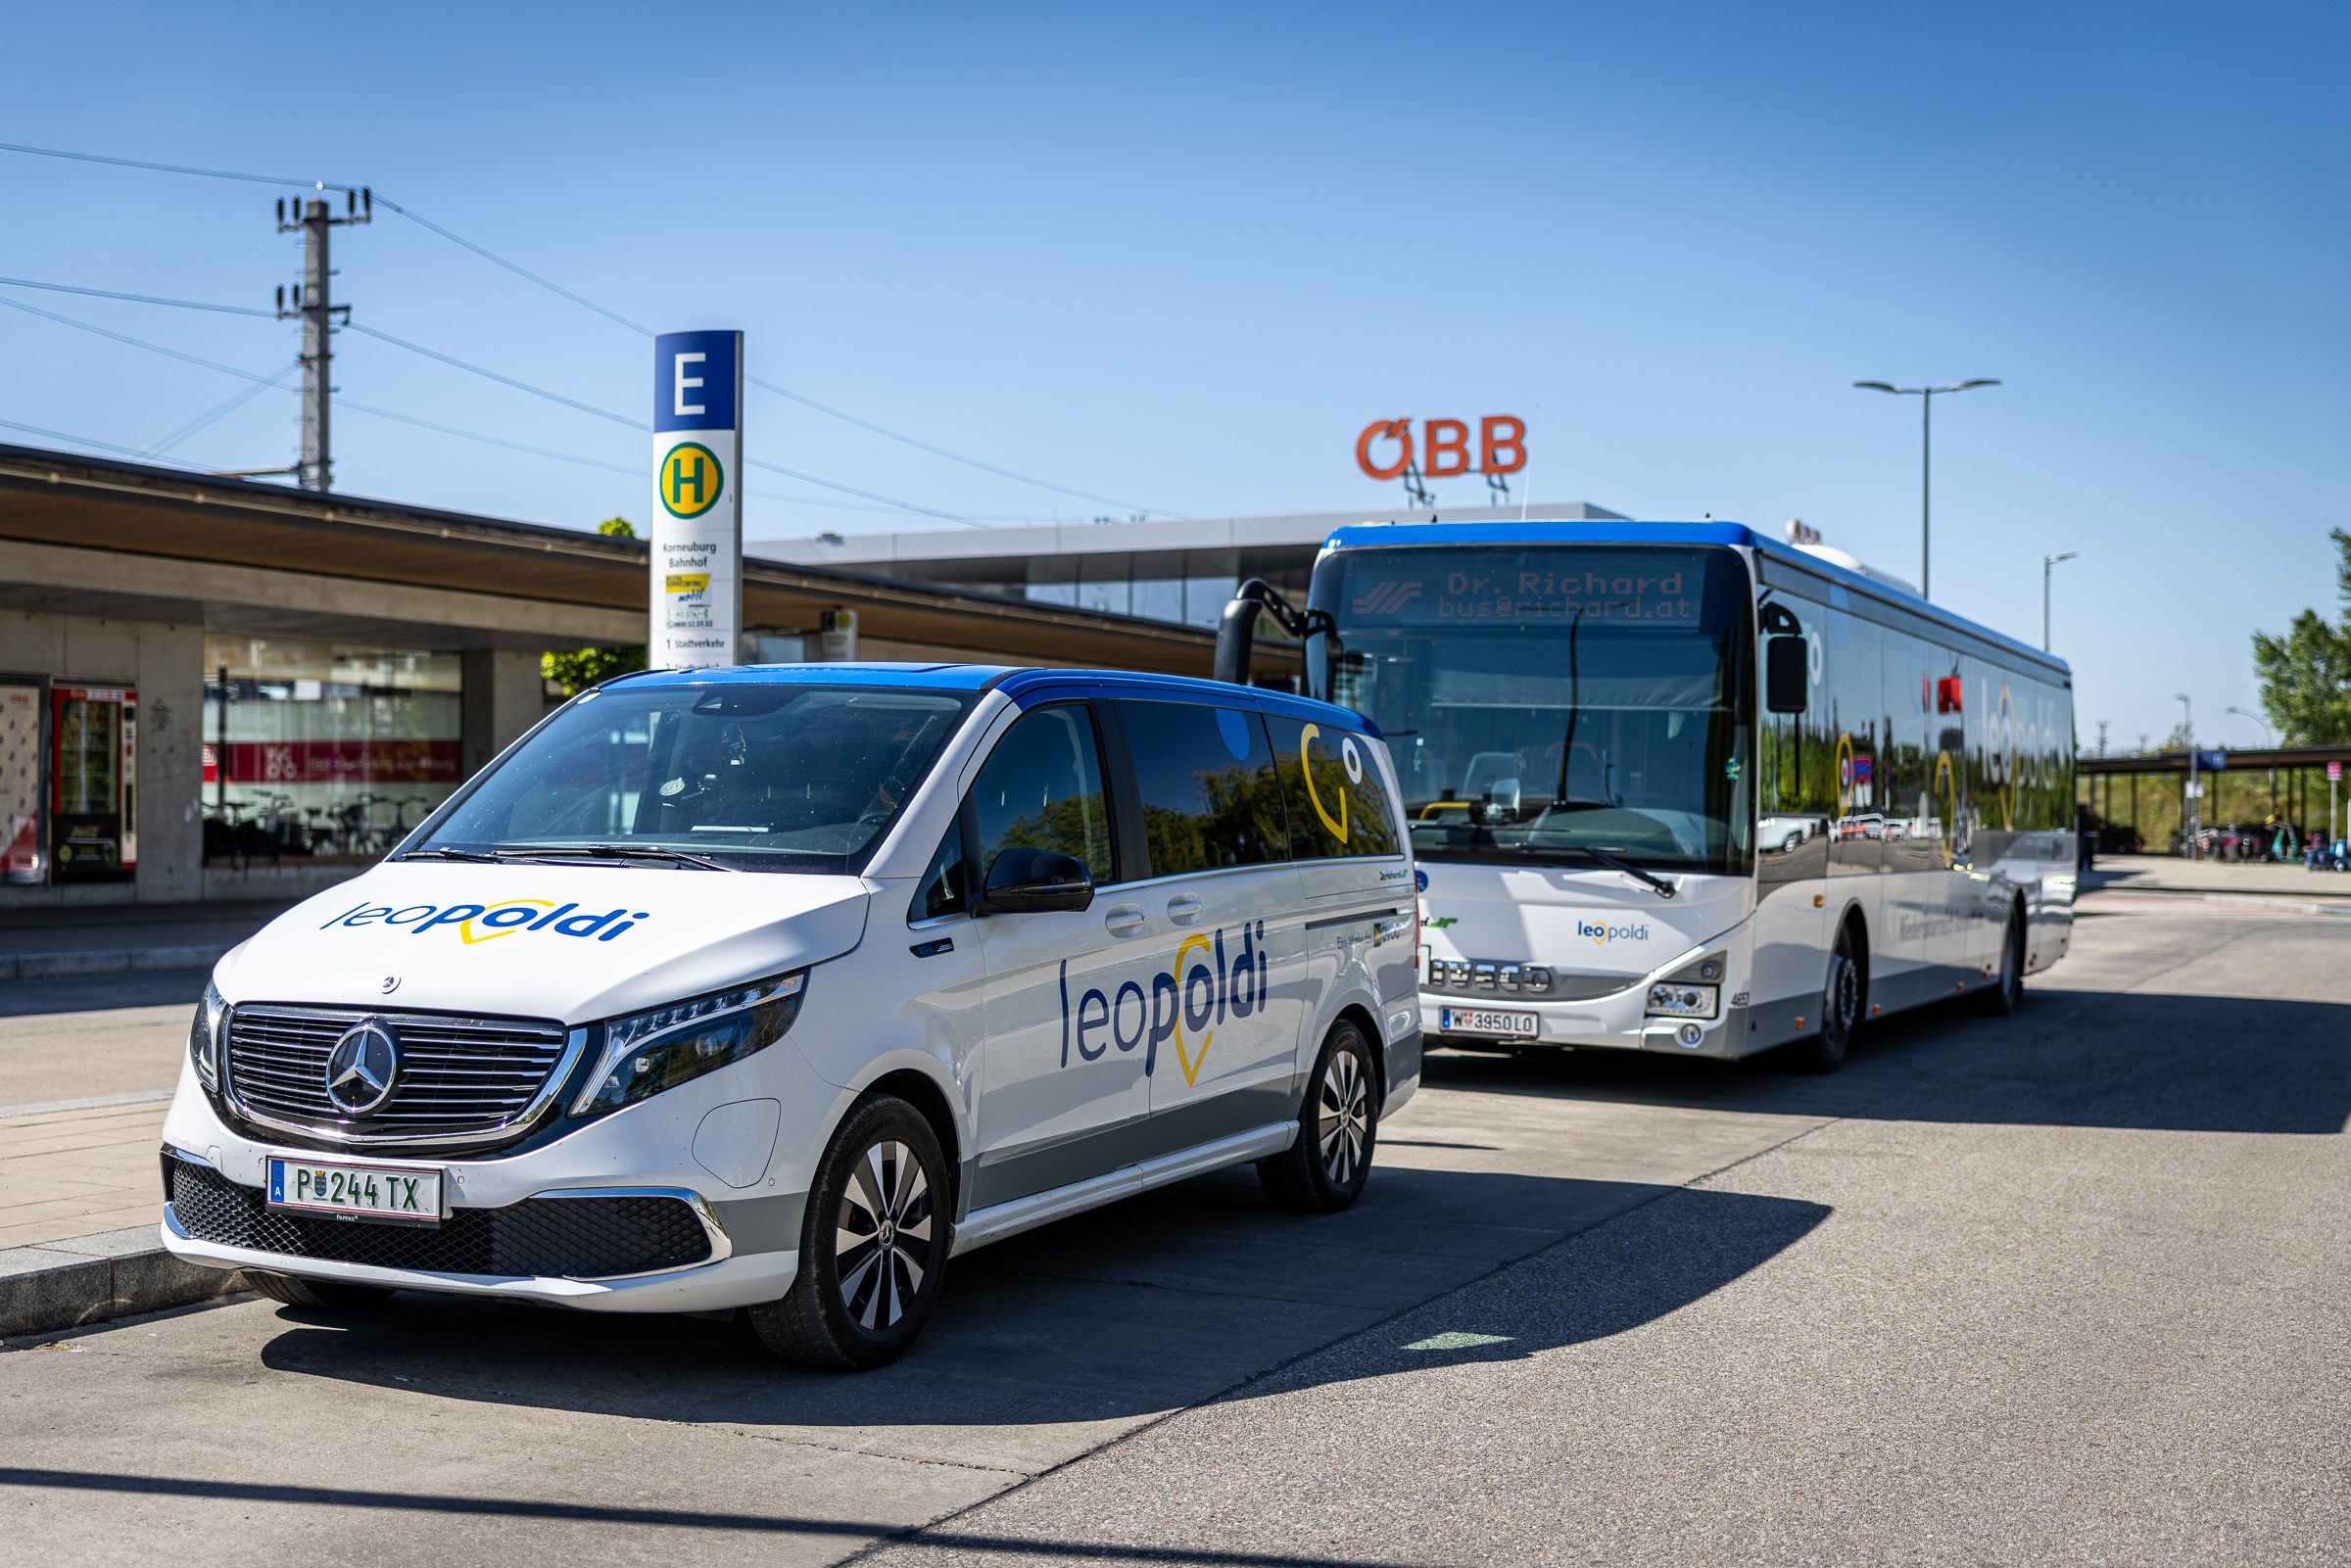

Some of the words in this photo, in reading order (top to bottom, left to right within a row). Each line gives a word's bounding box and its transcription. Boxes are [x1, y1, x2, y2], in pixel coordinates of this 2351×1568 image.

[674, 352, 706, 416] E
[1356, 415, 1527, 482] ÖBB
[673, 456, 704, 504] H
[663, 542, 717, 554] Korneuburg
[669, 556, 707, 568] Bahnhof
[1448, 572, 1501, 594] Dr.
[1518, 572, 1683, 594] Richard
[675, 639, 725, 648] Stadtverkehr
[319, 901, 650, 942] leopoldi
[1577, 921, 1650, 943] leopoldi
[1431, 960, 1551, 994] IVECO
[1059, 920, 1268, 1078] leopoldi
[1452, 1011, 1463, 1027] W
[1474, 1014, 1511, 1031] 3950
[297, 1167, 311, 1200] P
[330, 1171, 378, 1207] 244
[386, 1176, 417, 1210] TX
